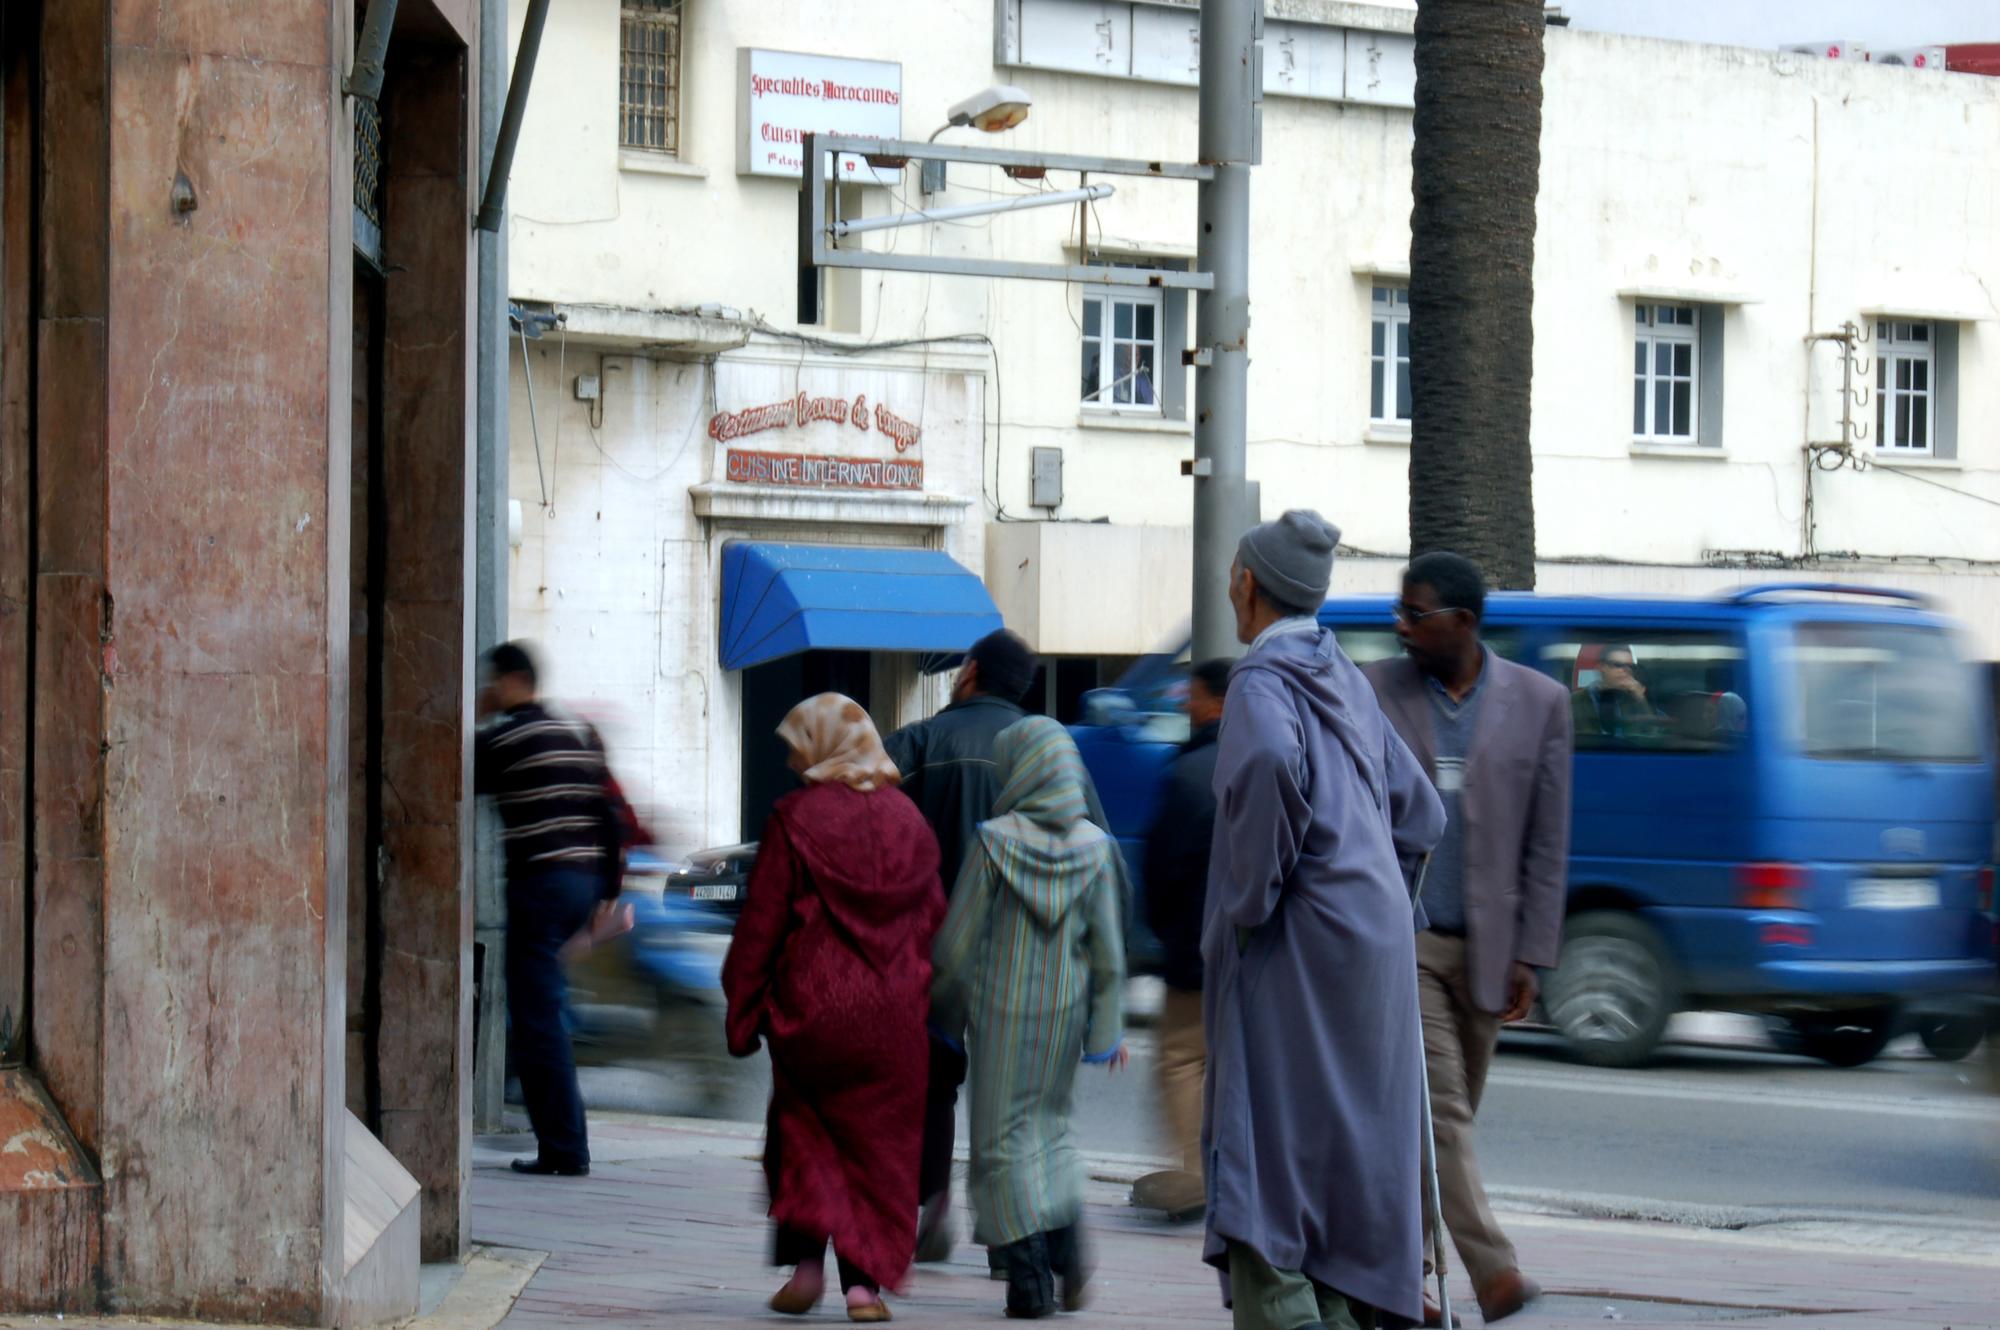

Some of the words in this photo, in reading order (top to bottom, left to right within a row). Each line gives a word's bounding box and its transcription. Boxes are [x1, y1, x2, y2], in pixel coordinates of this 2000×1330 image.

[821, 79, 899, 105] Marocaines
[852, 394, 869, 431] de
[728, 454, 799, 481] CUISINE
[802, 454, 923, 487] INTERNATIONAL
